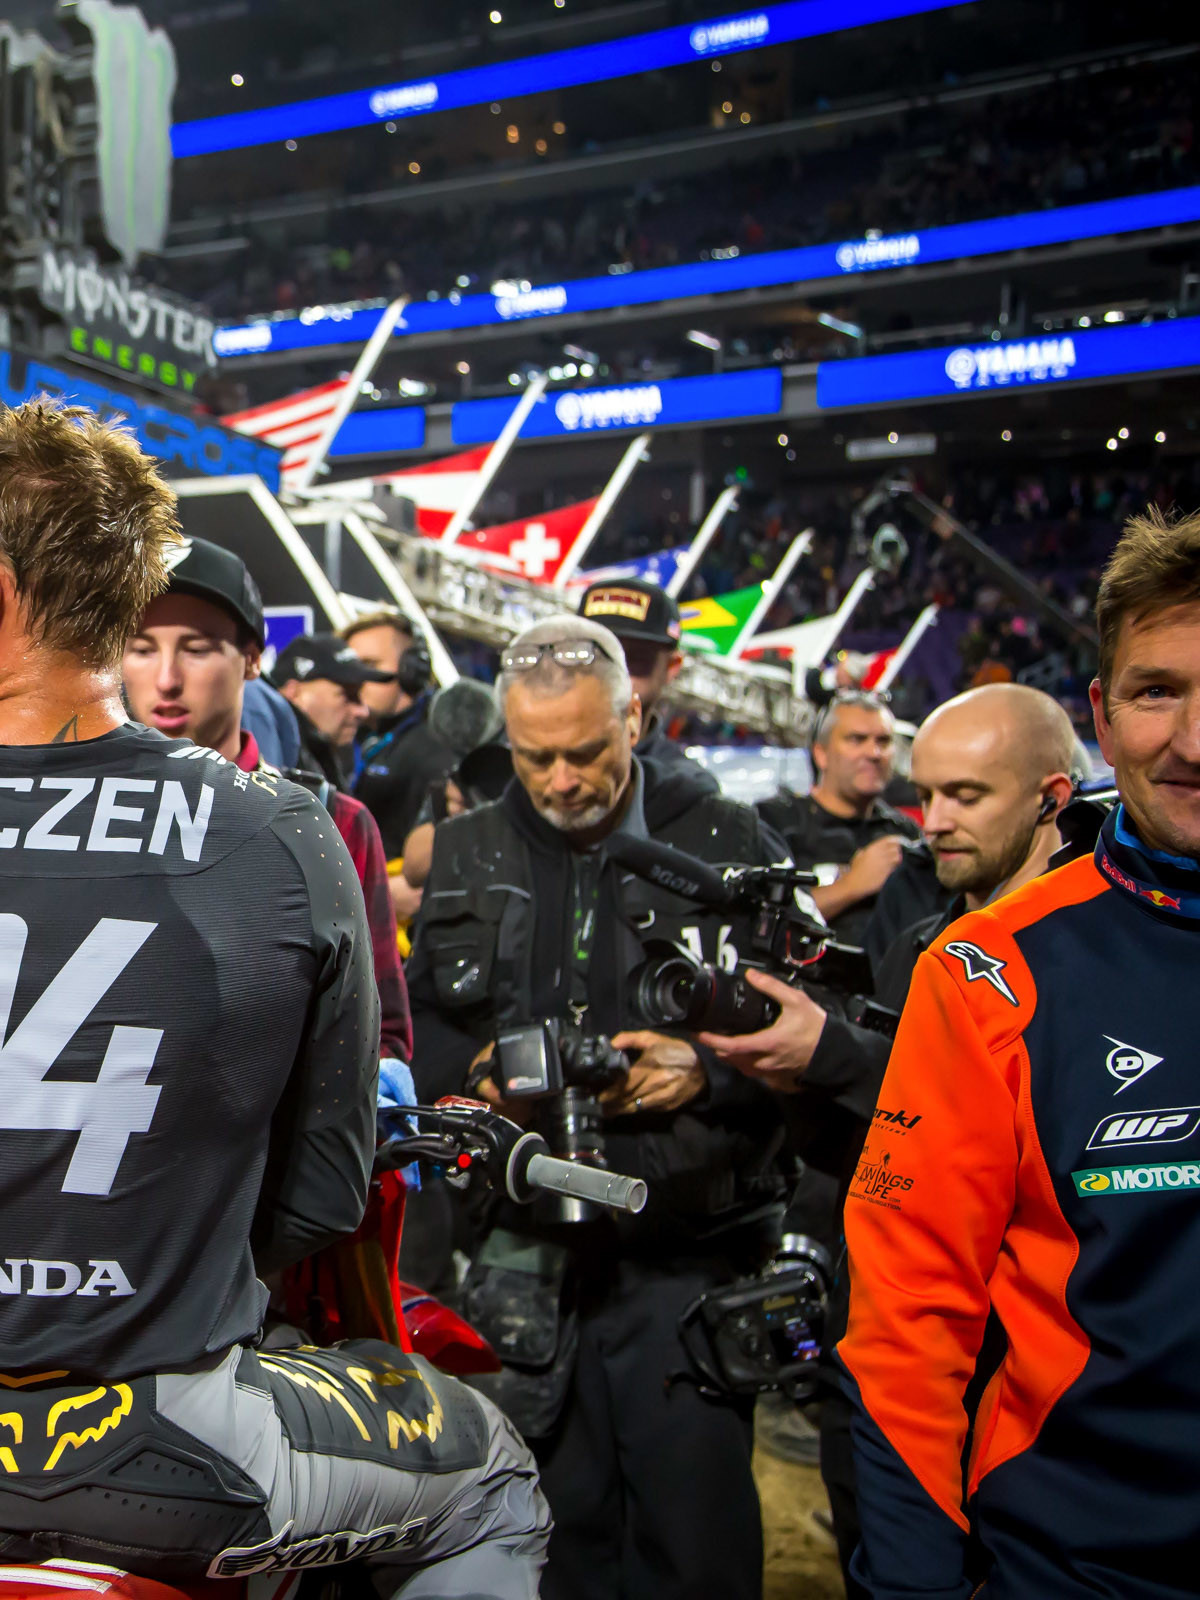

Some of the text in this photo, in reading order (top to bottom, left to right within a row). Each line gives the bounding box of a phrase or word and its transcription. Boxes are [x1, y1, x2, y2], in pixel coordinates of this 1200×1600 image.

[42, 250, 217, 368] MONSTER
[70, 327, 198, 392] ENERGY
[975, 337, 1076, 376] YAMAHA
[873, 1108, 922, 1129] nkl
[1101, 1114, 1190, 1142] WP
[860, 1165, 914, 1191] WINGS
[864, 1180, 892, 1199] LIFE
[1111, 1165, 1200, 1190] MOTOR
